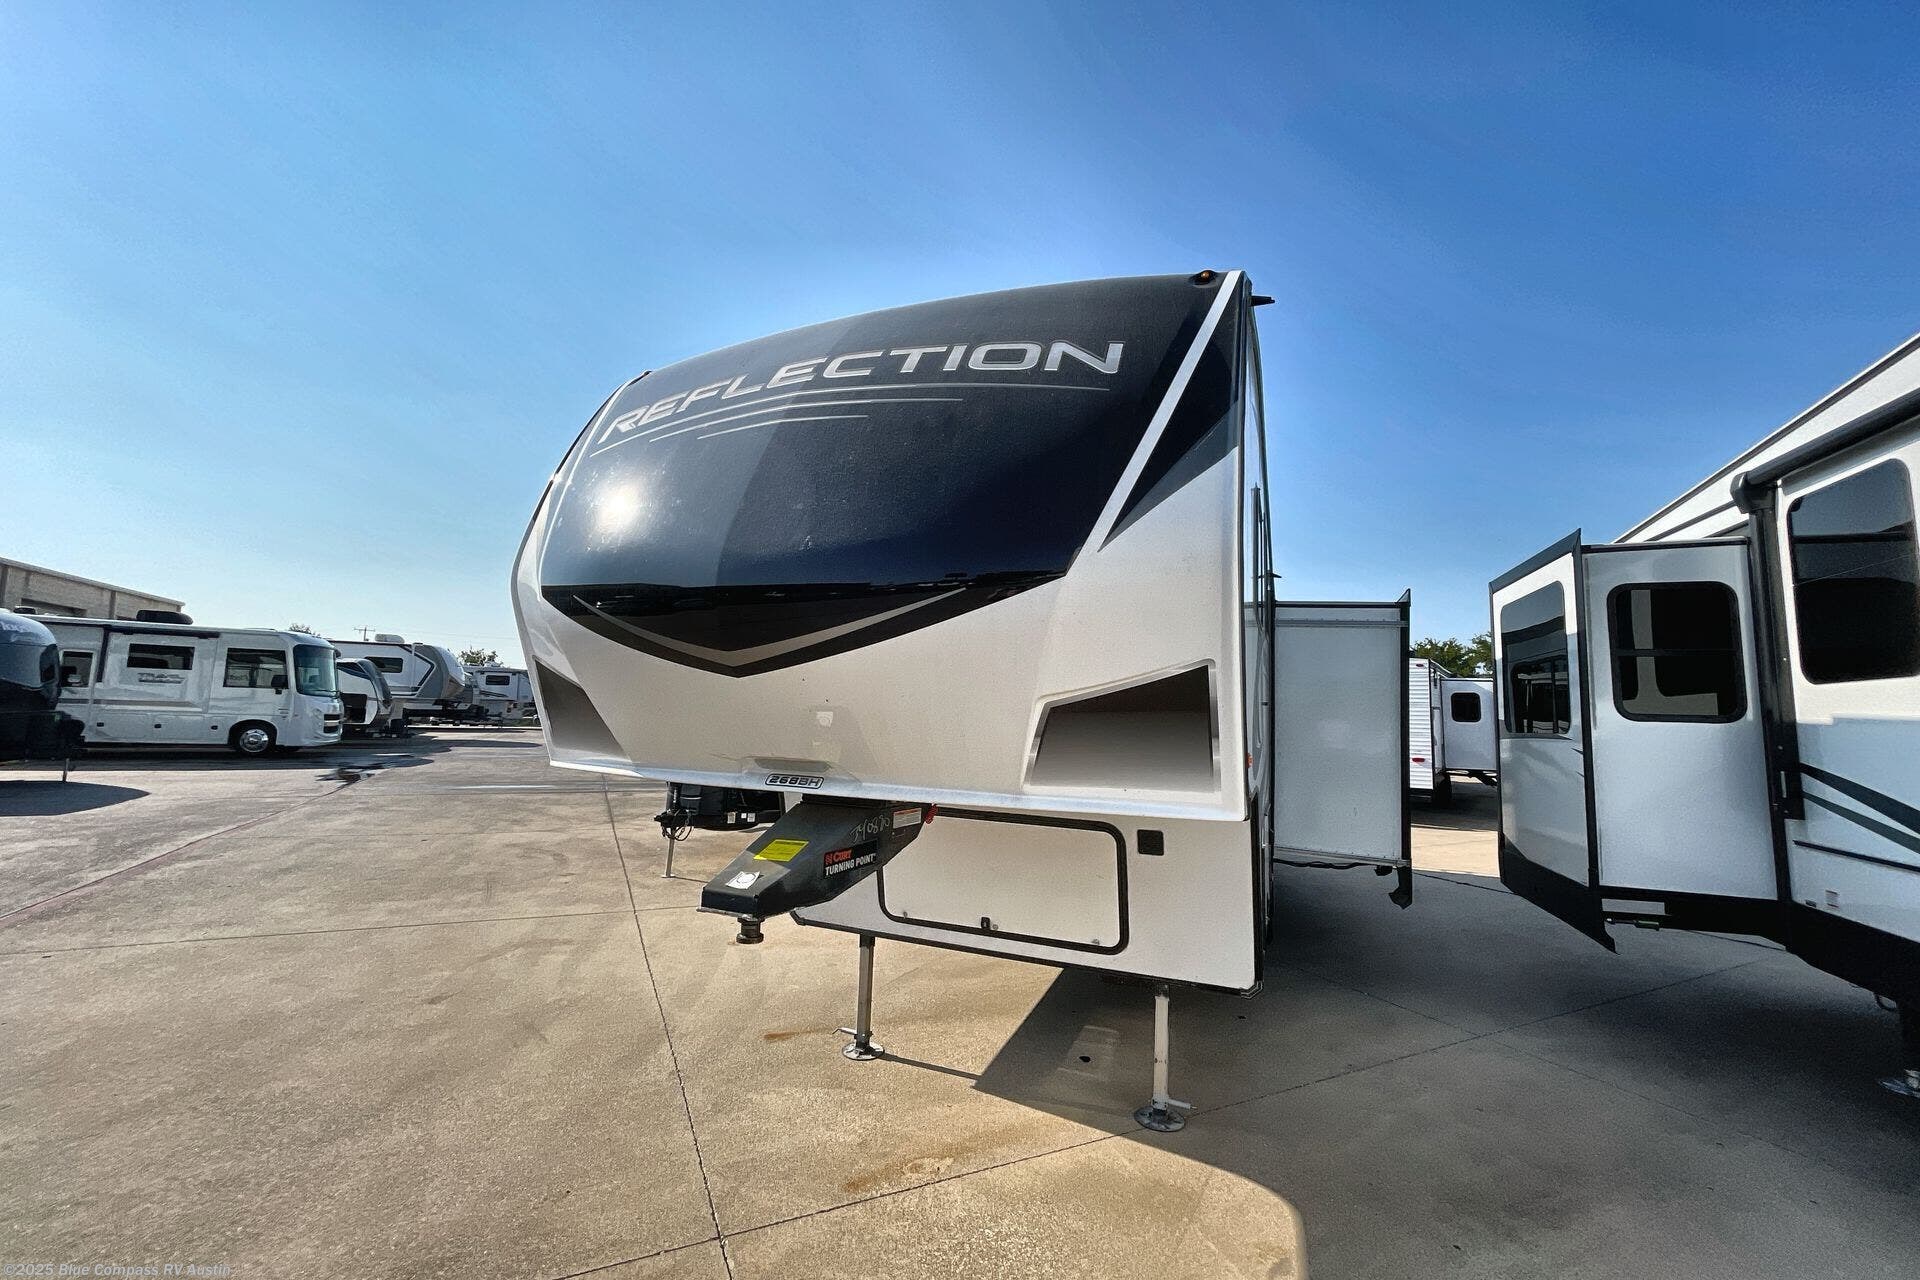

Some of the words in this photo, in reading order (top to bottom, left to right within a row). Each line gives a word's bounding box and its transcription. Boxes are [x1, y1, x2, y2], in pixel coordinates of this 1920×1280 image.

[598, 340, 1125, 444] REFLECTION
[769, 775, 820, 787] 268BH
[825, 860, 855, 876] TURNING
[855, 853, 877, 867] POINT
